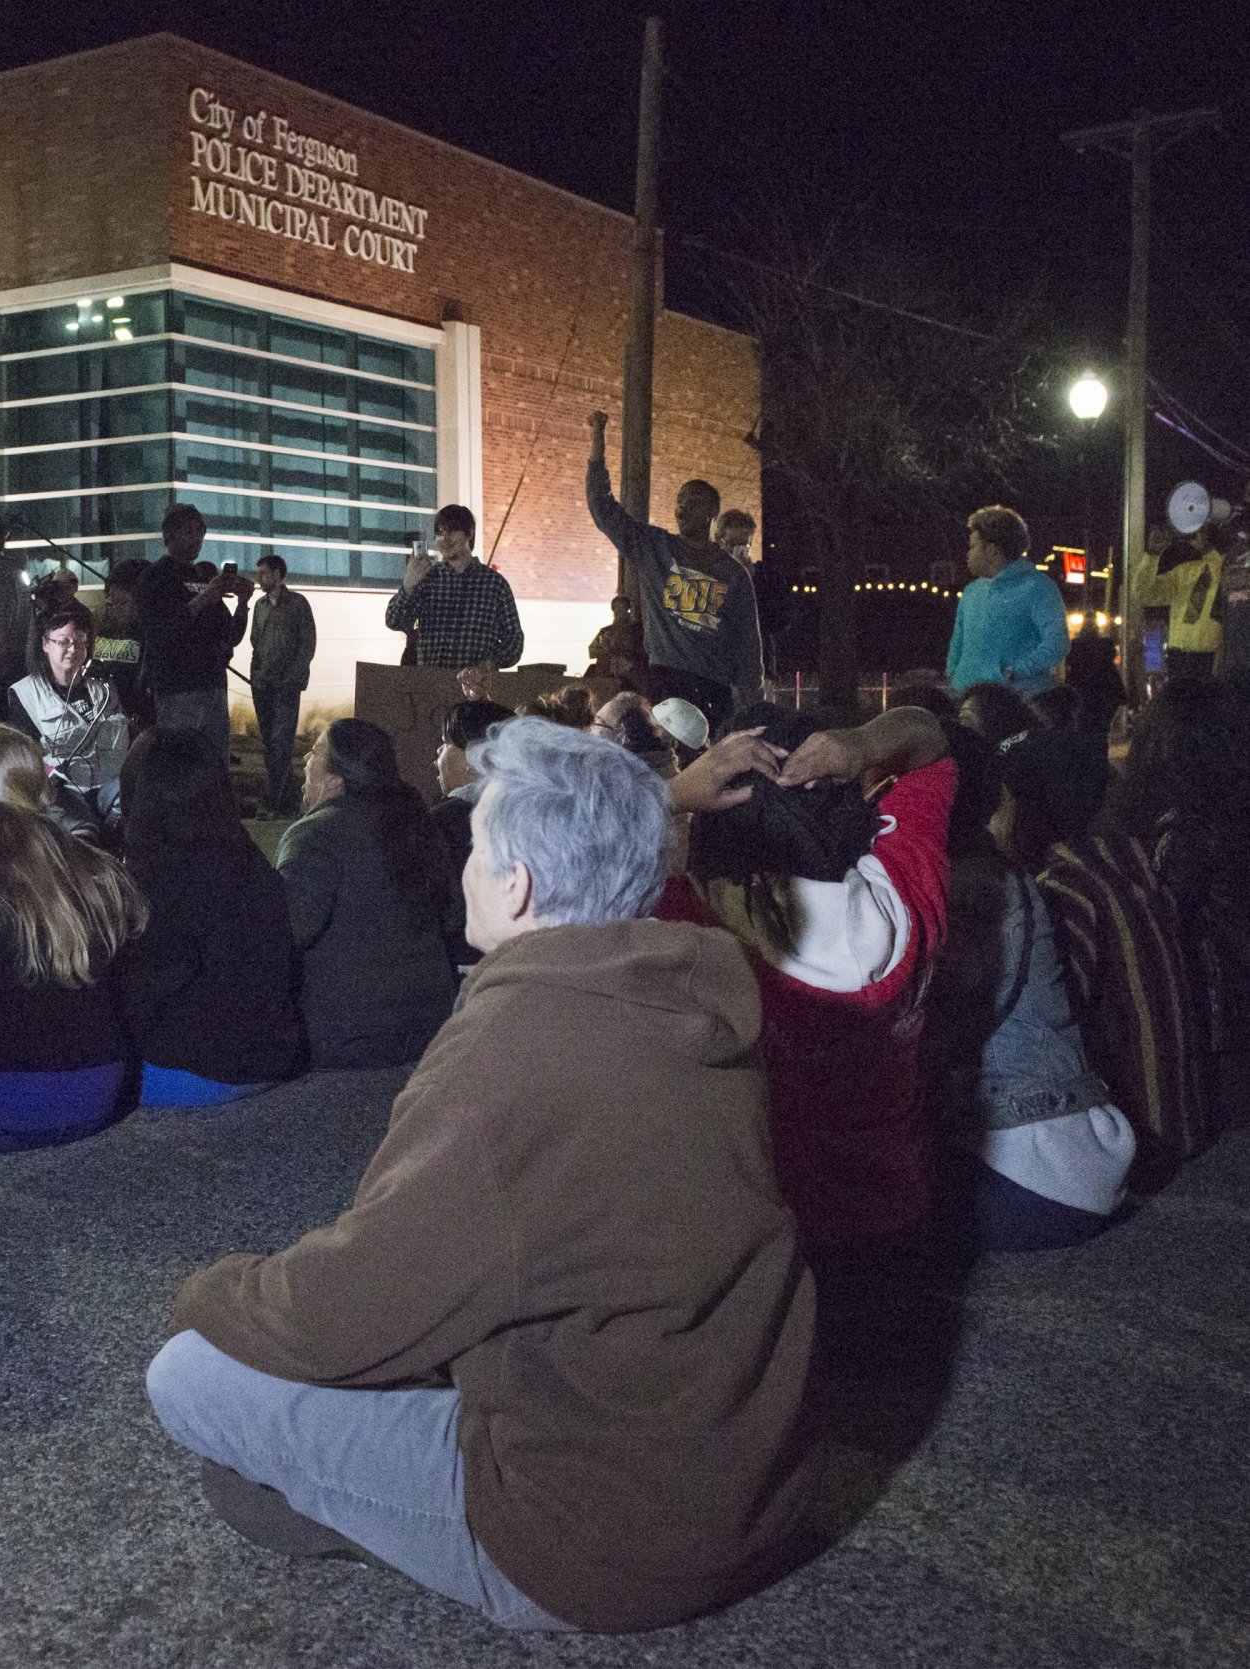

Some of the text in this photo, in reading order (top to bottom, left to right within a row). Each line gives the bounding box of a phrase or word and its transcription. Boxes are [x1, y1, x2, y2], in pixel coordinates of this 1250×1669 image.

[190, 88, 358, 177] City of Ferguson
[190, 131, 428, 239] POLICE DEPARTMENT
[191, 176, 418, 273] MUNICIPAL COURT
[663, 574, 729, 615] 2015
